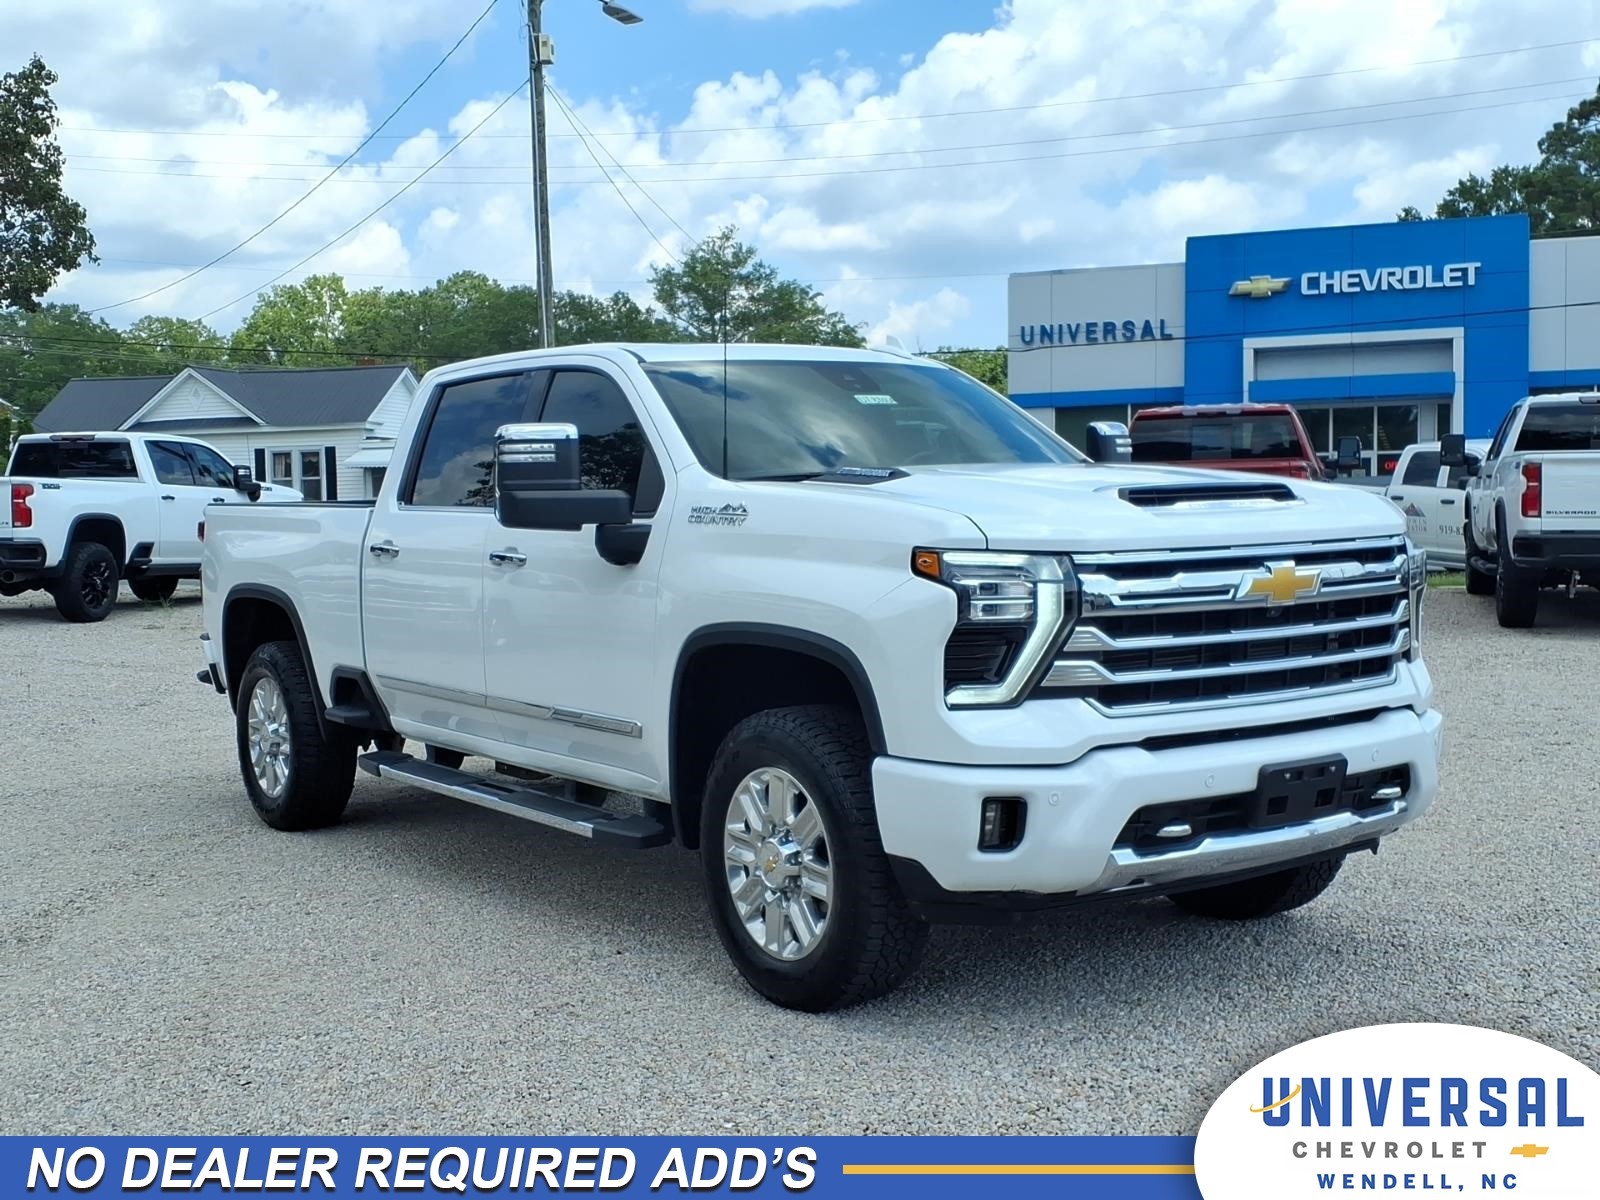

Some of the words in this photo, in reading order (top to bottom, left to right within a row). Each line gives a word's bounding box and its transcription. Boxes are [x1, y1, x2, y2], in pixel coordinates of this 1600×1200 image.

[1301, 262, 1481, 296] CHEVROLET
[1020, 318, 1174, 346] UNIVERSAL
[691, 506, 718, 514] HIGH
[688, 515, 746, 526] COUNTRY
